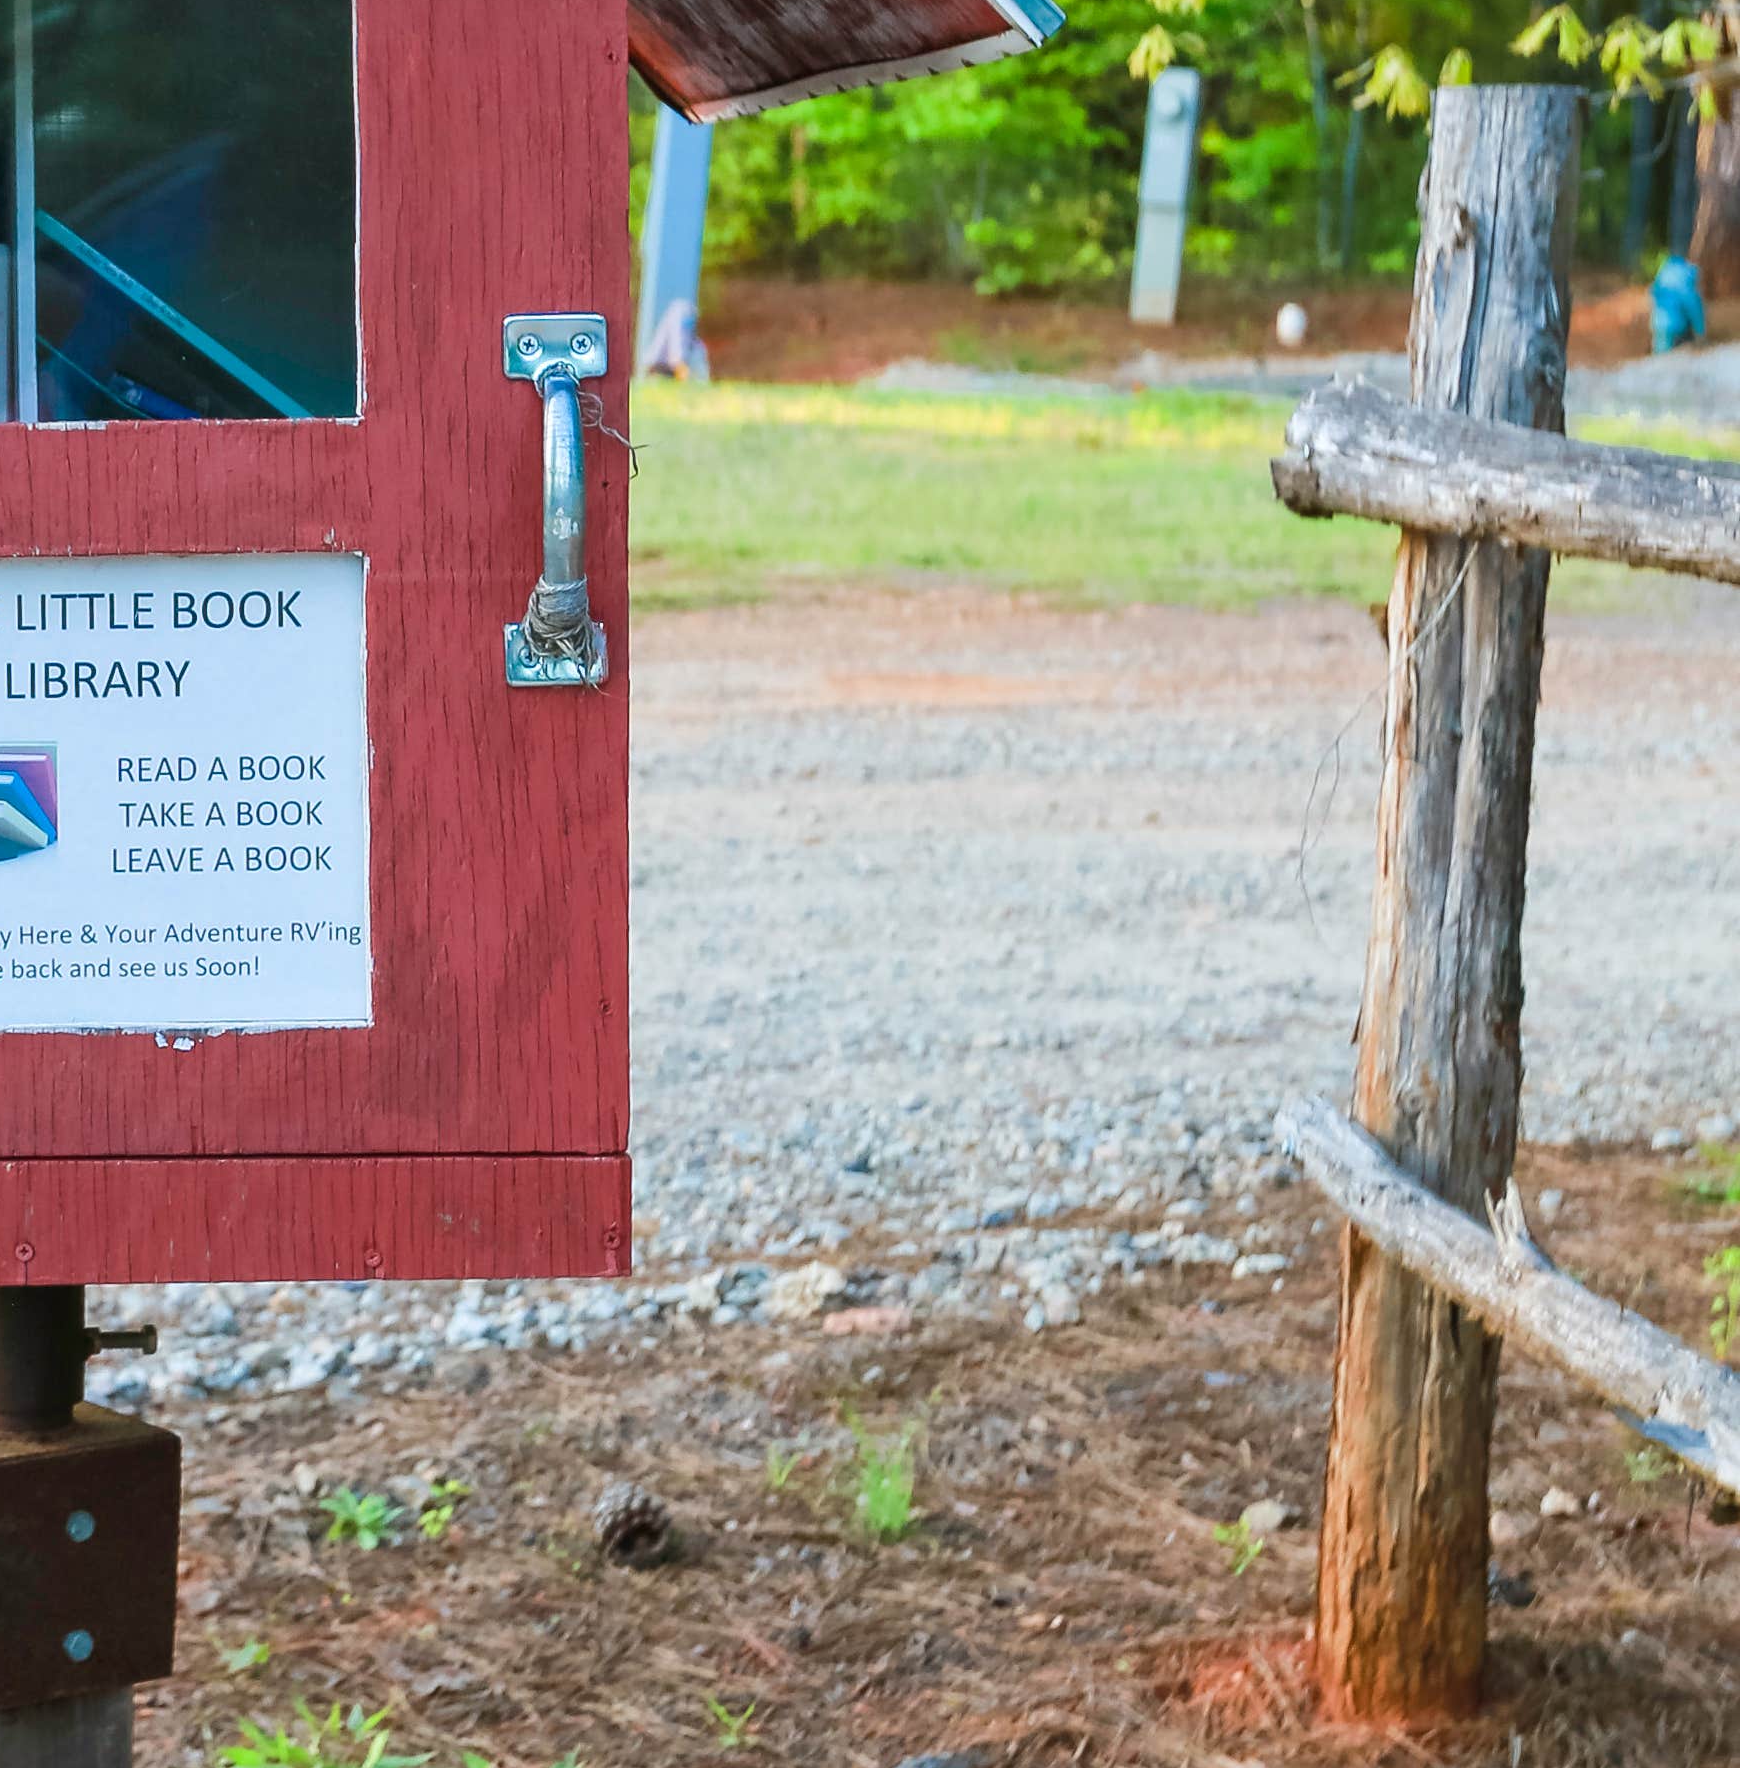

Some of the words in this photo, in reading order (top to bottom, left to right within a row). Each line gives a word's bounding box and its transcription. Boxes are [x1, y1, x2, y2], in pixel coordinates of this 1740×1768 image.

[16, 592, 155, 631] LITTLE
[172, 590, 303, 630] BOOK
[5, 659, 191, 700] LIBRARY
[117, 756, 197, 783] READ
[206, 756, 229, 782] A
[238, 754, 327, 782] BOOK
[117, 801, 195, 829] TAKE
[204, 801, 227, 828] A
[236, 800, 323, 827] BOOK
[112, 846, 205, 874] LEAVE
[213, 846, 235, 873] A
[245, 845, 333, 872] BOOK
[19, 925, 73, 946] Here
[80, 923, 99, 945] &
[104, 924, 158, 944] Your
[163, 921, 283, 944] Adventure
[11, 957, 64, 980] back
[69, 956, 111, 979] and
[118, 962, 157, 978] see
[163, 961, 189, 978] us
[195, 955, 260, 977] Soon!
